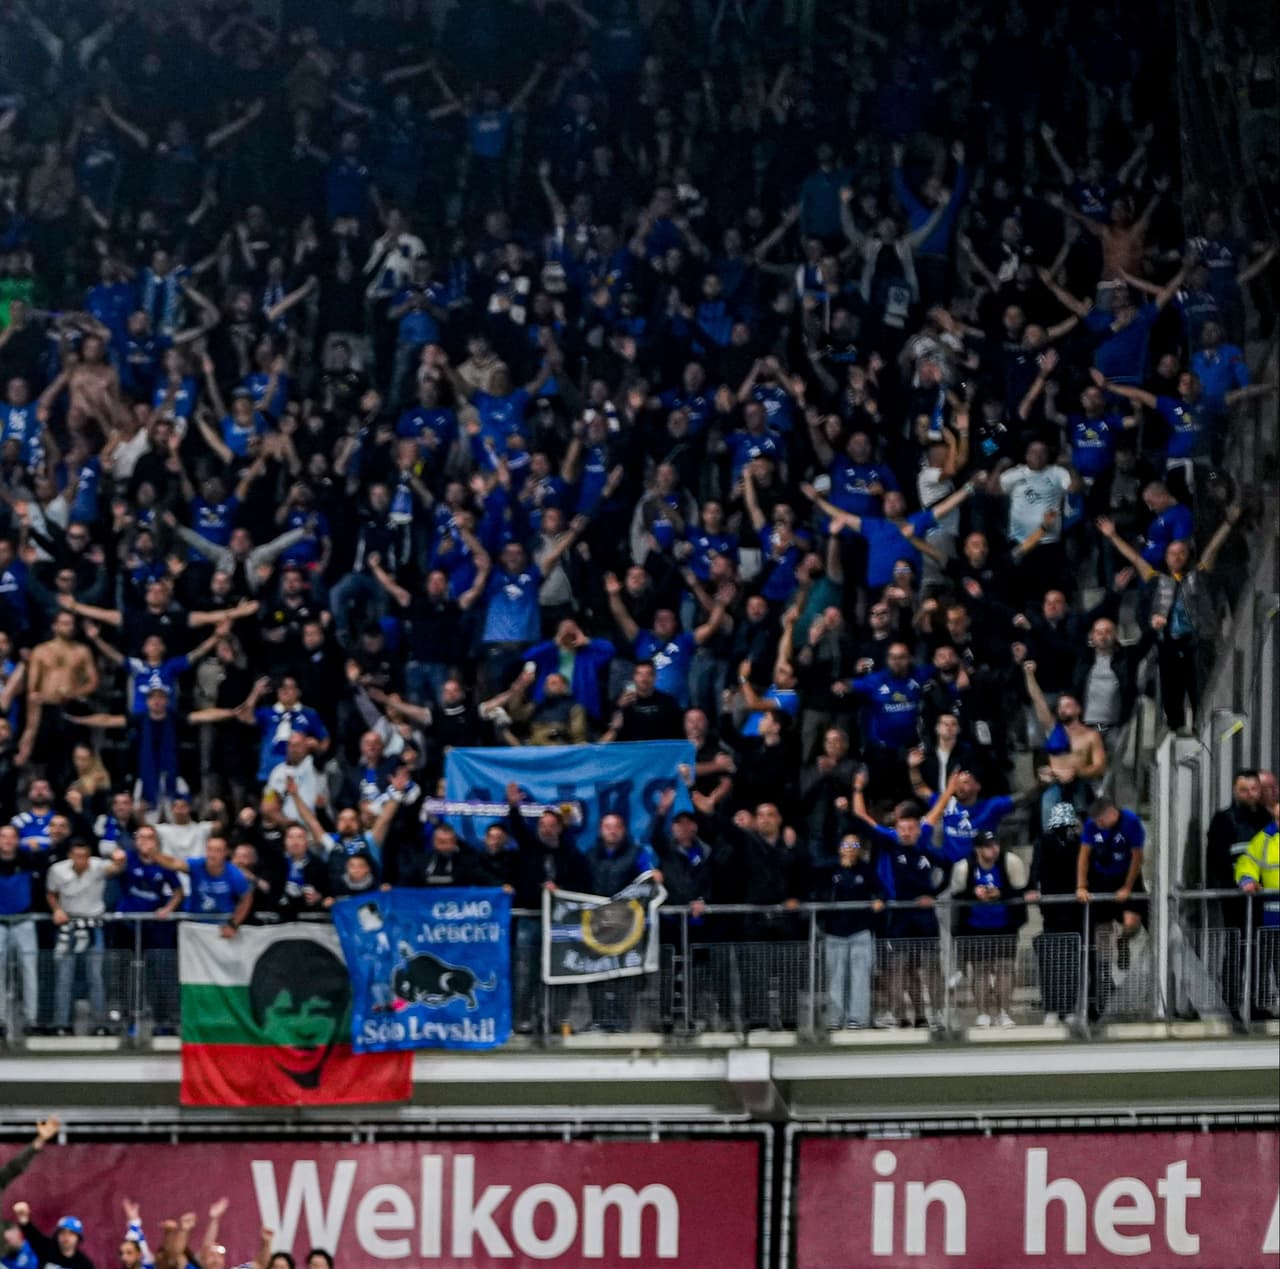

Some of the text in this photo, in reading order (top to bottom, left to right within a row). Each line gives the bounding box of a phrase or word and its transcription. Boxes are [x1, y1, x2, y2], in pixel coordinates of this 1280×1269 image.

[252, 1153, 679, 1259] Welkom
[871, 1149, 967, 1256] in
[1024, 1147, 1202, 1256] het
